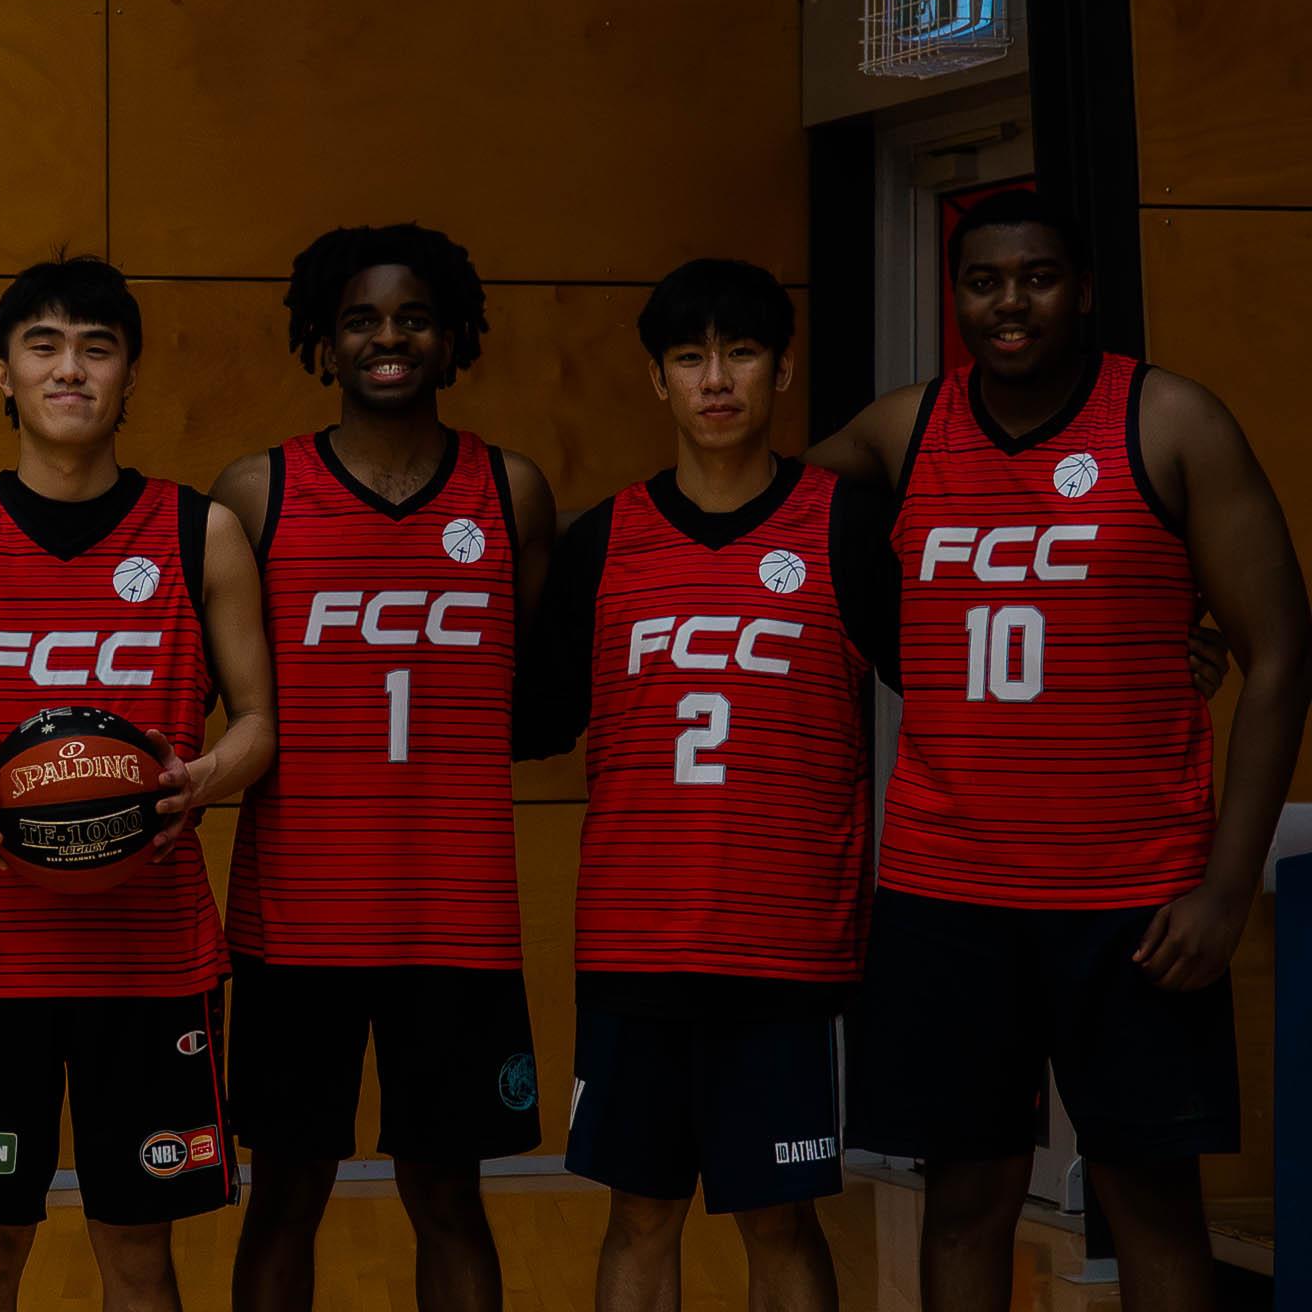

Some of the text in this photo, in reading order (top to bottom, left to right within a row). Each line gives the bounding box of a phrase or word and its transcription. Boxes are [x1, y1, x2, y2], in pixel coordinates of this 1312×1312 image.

[919, 524, 1100, 582] FCC
[303, 591, 490, 646] FCC
[627, 616, 805, 675] FCC
[965, 605, 1045, 702] 10
[384, 669, 411, 763] 1
[673, 692, 732, 785] 2
[10, 754, 144, 799] SPALDING
[19, 809, 143, 846] TF-1000
[151, 1144, 180, 1165] NBL
